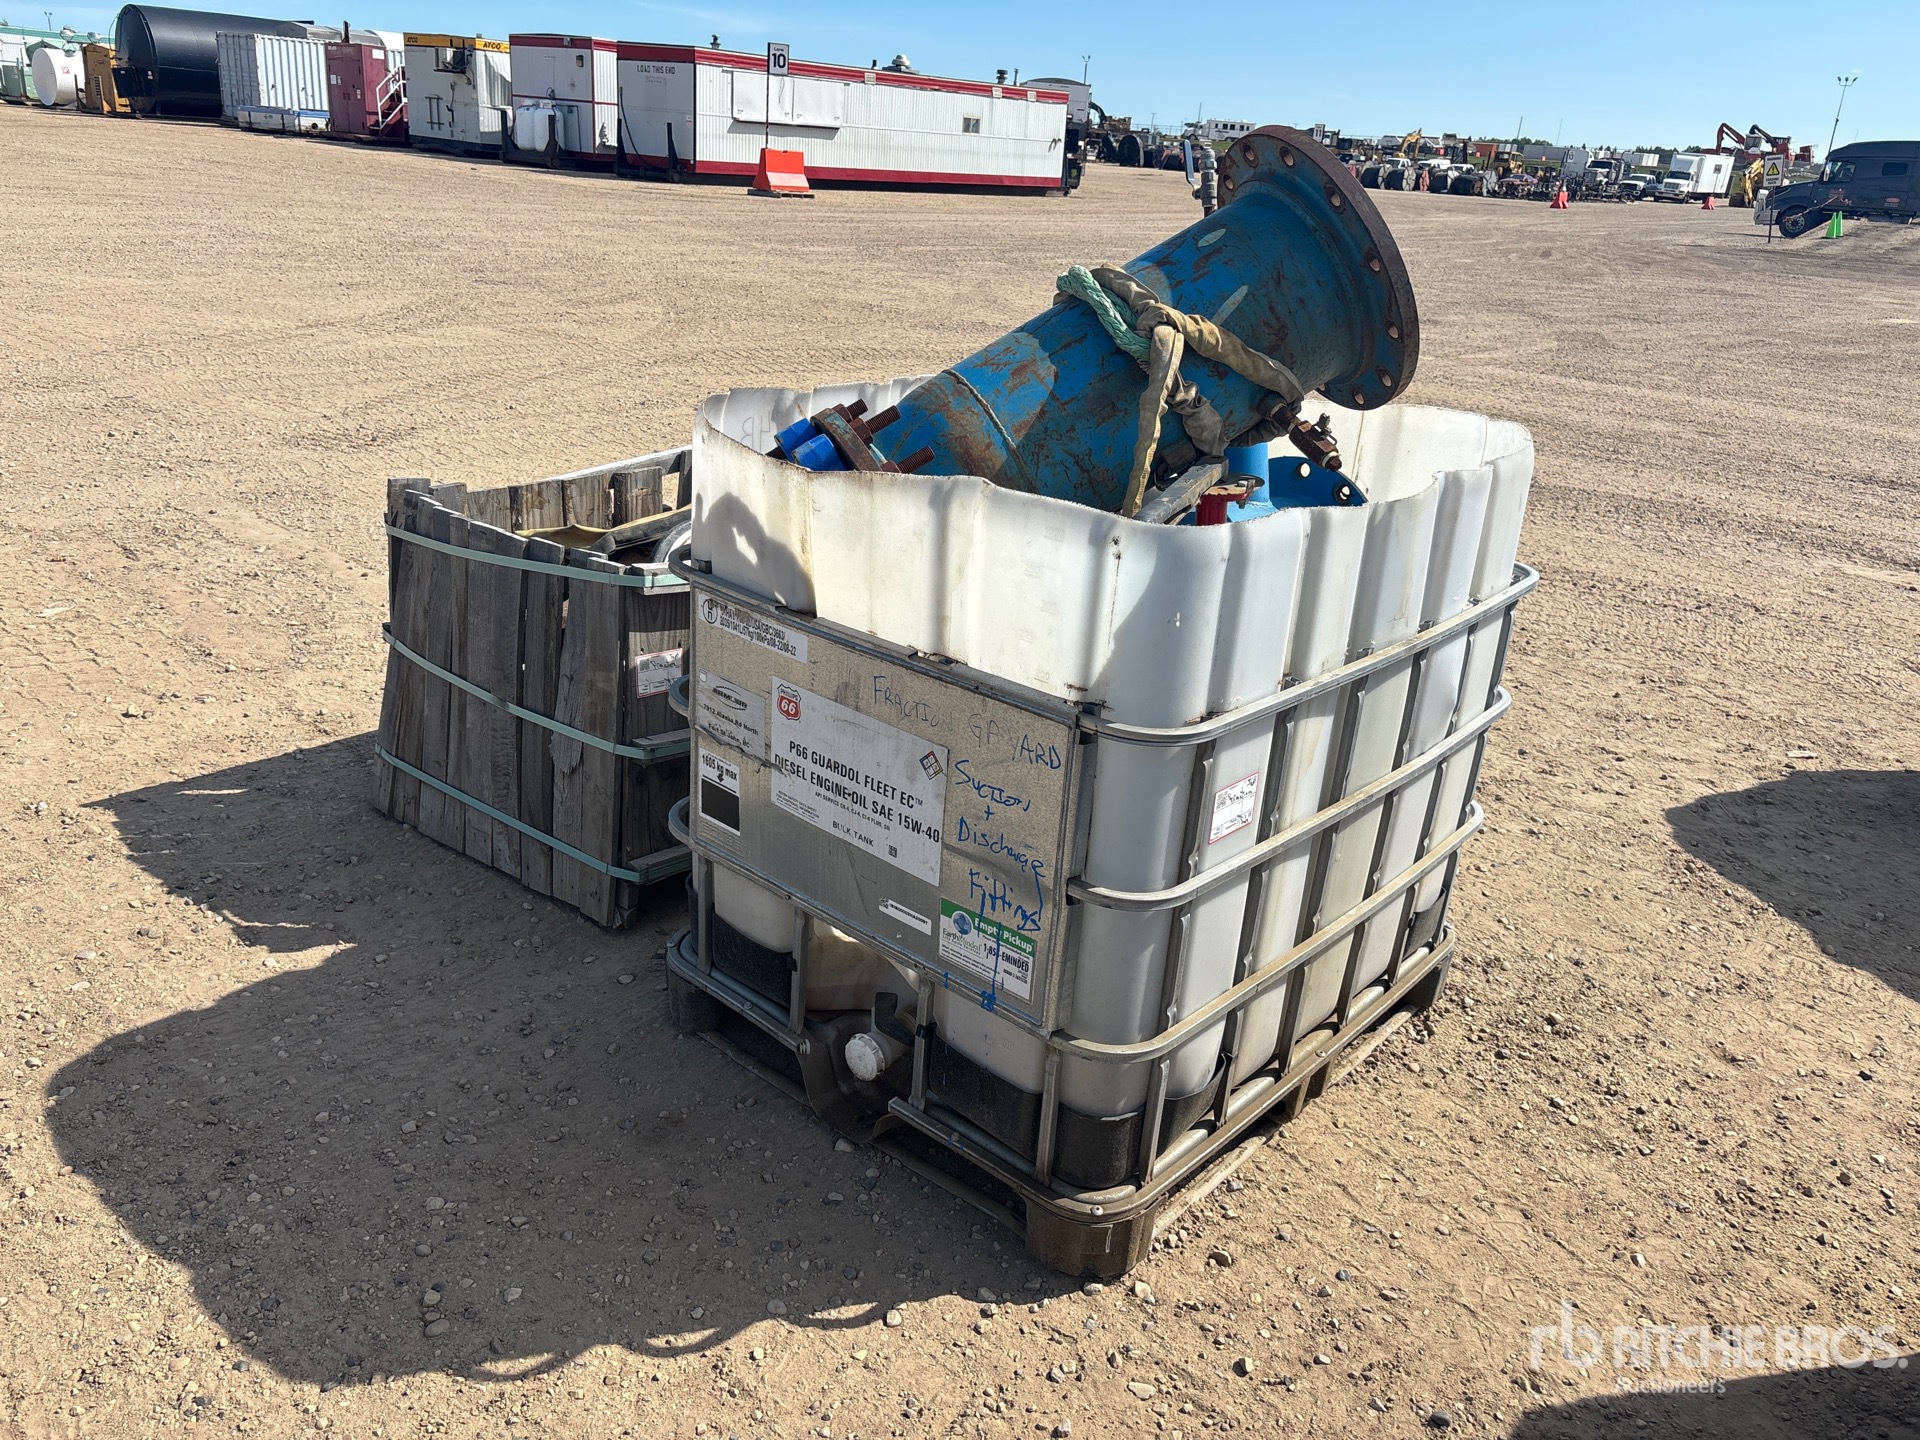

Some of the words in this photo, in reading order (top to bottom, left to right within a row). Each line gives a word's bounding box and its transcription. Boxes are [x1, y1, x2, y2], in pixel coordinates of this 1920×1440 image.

[482, 42, 502, 50] ATCO
[771, 52, 786, 69] 10
[636, 64, 651, 74] LOAD
[652, 65, 664, 74] THIS
[664, 66, 676, 75] END
[781, 699, 796, 715] 66
[743, 723, 758, 736] North
[702, 754, 716, 770] 1605
[724, 767, 738, 781] max
[789, 740, 808, 760] P66
[811, 751, 861, 785] GUARDOL
[864, 774, 898, 801] FLEET
[774, 753, 808, 781] DIESEL
[810, 772, 848, 800] ENGINE
[852, 792, 868, 810] OIL
[872, 800, 894, 822] SAE
[897, 812, 940, 843] 15W-40
[822, 794, 840, 807] SERVICE
[832, 820, 851, 836] BULK
[853, 830, 874, 848] TANK
[1003, 930, 1033, 953] Pickup
